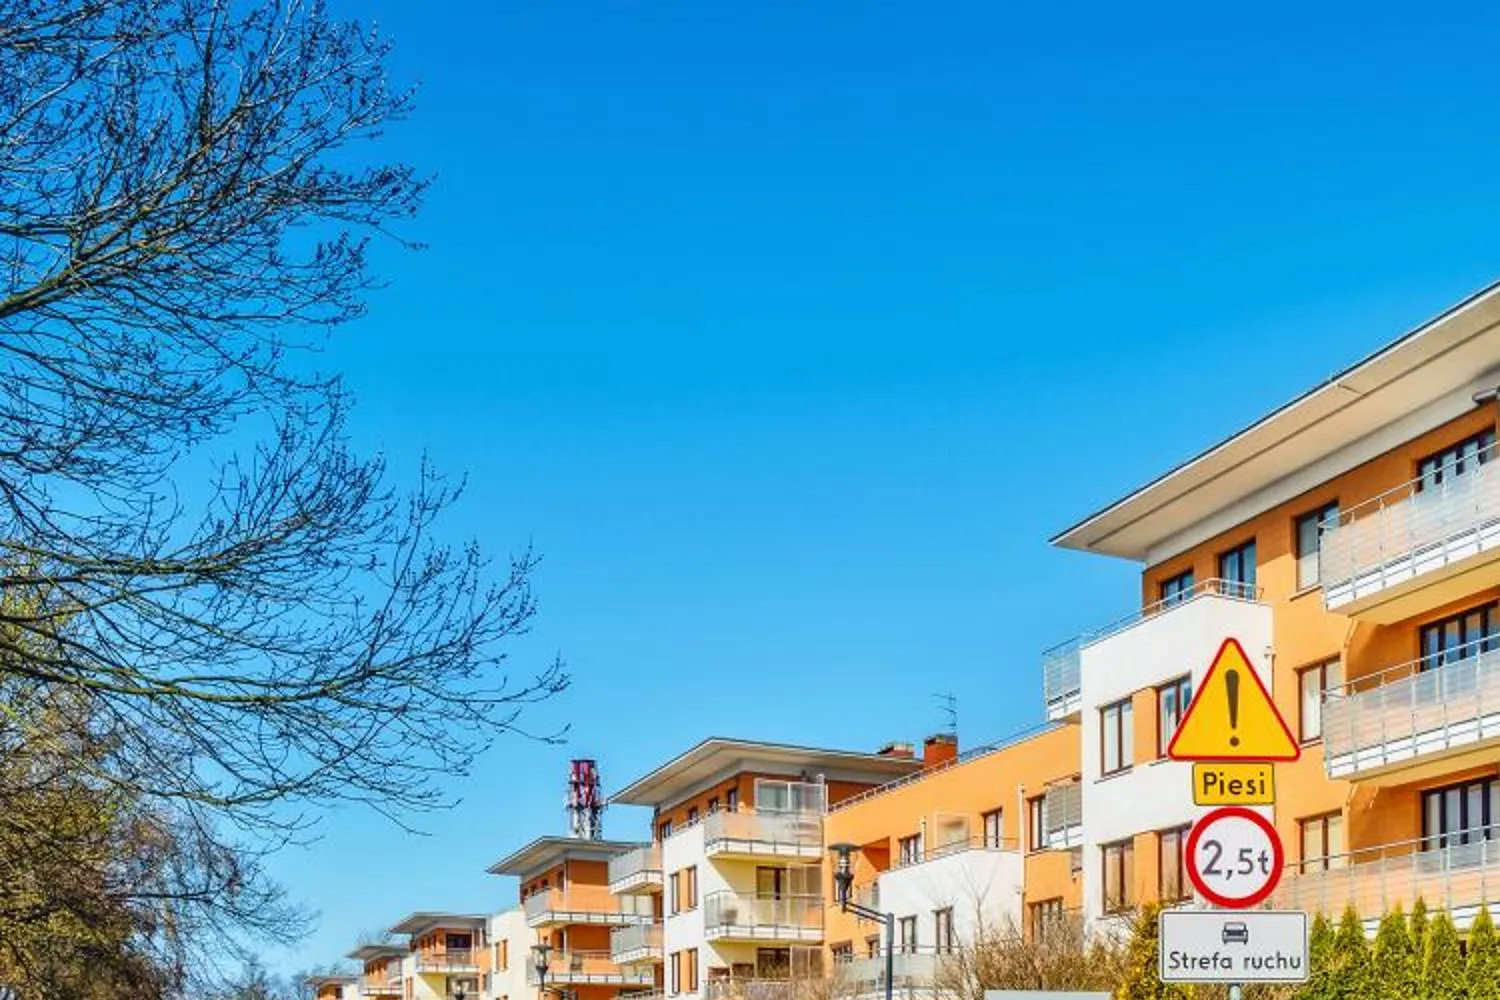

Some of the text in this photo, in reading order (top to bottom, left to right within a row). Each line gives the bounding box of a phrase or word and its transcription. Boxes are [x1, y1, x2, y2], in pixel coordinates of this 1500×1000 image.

[1203, 772, 1265, 795] Piesi
[1201, 839, 1268, 880] 2,5t
[1169, 951, 1301, 970] Strefa ruchu
